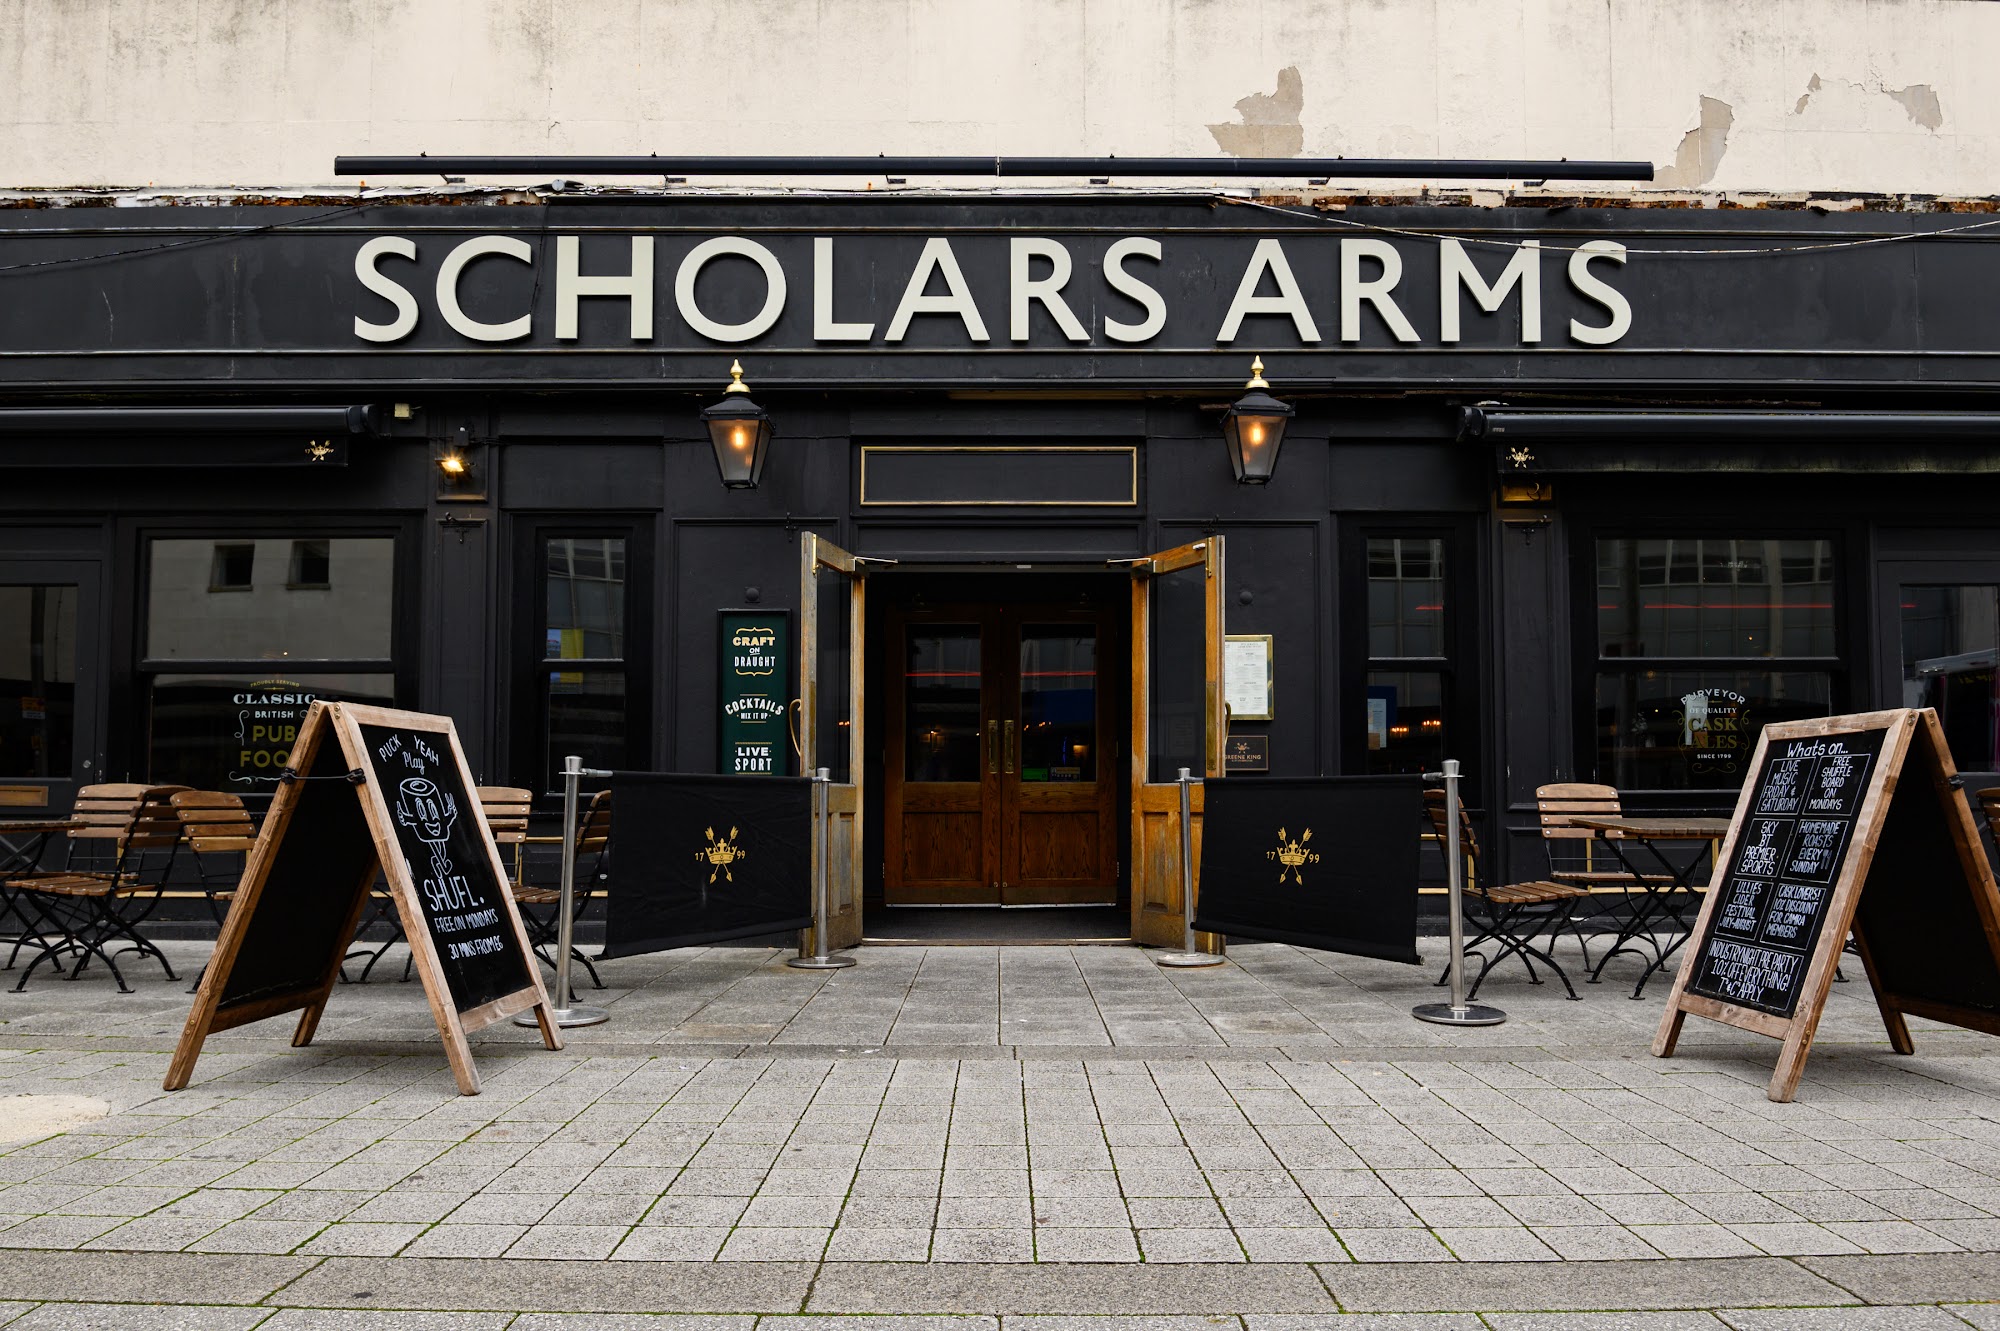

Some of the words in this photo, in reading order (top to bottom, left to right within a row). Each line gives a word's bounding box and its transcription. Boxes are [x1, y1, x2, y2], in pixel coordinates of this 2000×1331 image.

[353, 235, 1167, 343] SCHOLARS
[1216, 238, 1633, 345] ARMS
[732, 636, 776, 647] CRAFT
[734, 656, 776, 667] DRAUGHT
[250, 679, 275, 688] PROUDLY
[276, 679, 301, 688] SERVING
[232, 693, 316, 705] CLASSIC
[1680, 688, 1746, 706] PURVEYOR
[724, 697, 785, 716] COCKTAILS
[1702, 707, 1737, 715] QUALITY
[254, 710, 294, 719] BRITISH
[740, 712, 752, 720] MIX
[752, 712, 759, 720] IT
[760, 712, 769, 720] UP
[1688, 717, 1739, 732] CASK
[252, 725, 296, 743] PUB
[1690, 735, 1738, 749] ALES
[1786, 739, 1826, 758] Whats
[1828, 742, 1848, 755] on...
[378, 733, 402, 763] PUCK
[413, 734, 439, 766] YEAH
[737, 746, 769, 757] LIVE
[240, 749, 290, 769] FOO
[402, 751, 426, 776] Play
[734, 757, 773, 772] SPORT
[1780, 759, 1801, 773] LIVE
[1832, 756, 1852, 767] FREE
[1771, 771, 1799, 785] MUSIC
[1821, 766, 1854, 777] SHUFFLE
[1821, 776, 1845, 788] BOARD
[1762, 785, 1790, 798] FRIDAY
[1824, 787, 1837, 798] ON
[1760, 798, 1799, 812] SATURDAY
[1808, 798, 1844, 810] MONDAYS
[1760, 820, 1780, 834] SKY
[1798, 821, 1841, 835] HOMEMADE
[1758, 833, 1774, 847] BT
[1802, 833, 1834, 848] ROASTS
[694, 852, 705, 862] 17
[736, 850, 746, 860] 99
[1265, 851, 1276, 861] 17
[1308, 853, 1320, 864] 99
[1743, 845, 1777, 861] PREMIER
[1797, 847, 1823, 861] EVERY
[1740, 858, 1776, 875] SPORTS
[1789, 860, 1820, 874] SUNDAY
[423, 875, 485, 912] SHUFL.
[1732, 893, 1755, 907] CIDER
[1778, 885, 1795, 899] CASK
[1794, 886, 1821, 901] LOVERS!
[1724, 903, 1756, 919] FESTIVAL
[1784, 899, 1819, 915] DISCOUNT
[433, 916, 456, 933] FREE
[454, 915, 467, 931] ON
[465, 908, 499, 929] MONDAYS
[1769, 910, 1783, 924] FOR
[1783, 912, 1806, 927] CAMRA
[1765, 923, 1798, 939] MEMBERS
[448, 943, 460, 960] 30
[458, 940, 477, 957] MINS
[474, 936, 495, 955] FROM
[1759, 950, 1774, 969] PRE
[1770, 953, 1799, 974] PARTY
[1710, 958, 1729, 976] 10%
[1727, 961, 1743, 980] OFF
[1738, 963, 1791, 992] EVERYTHING!
[1736, 982, 1765, 1003] APPLY
